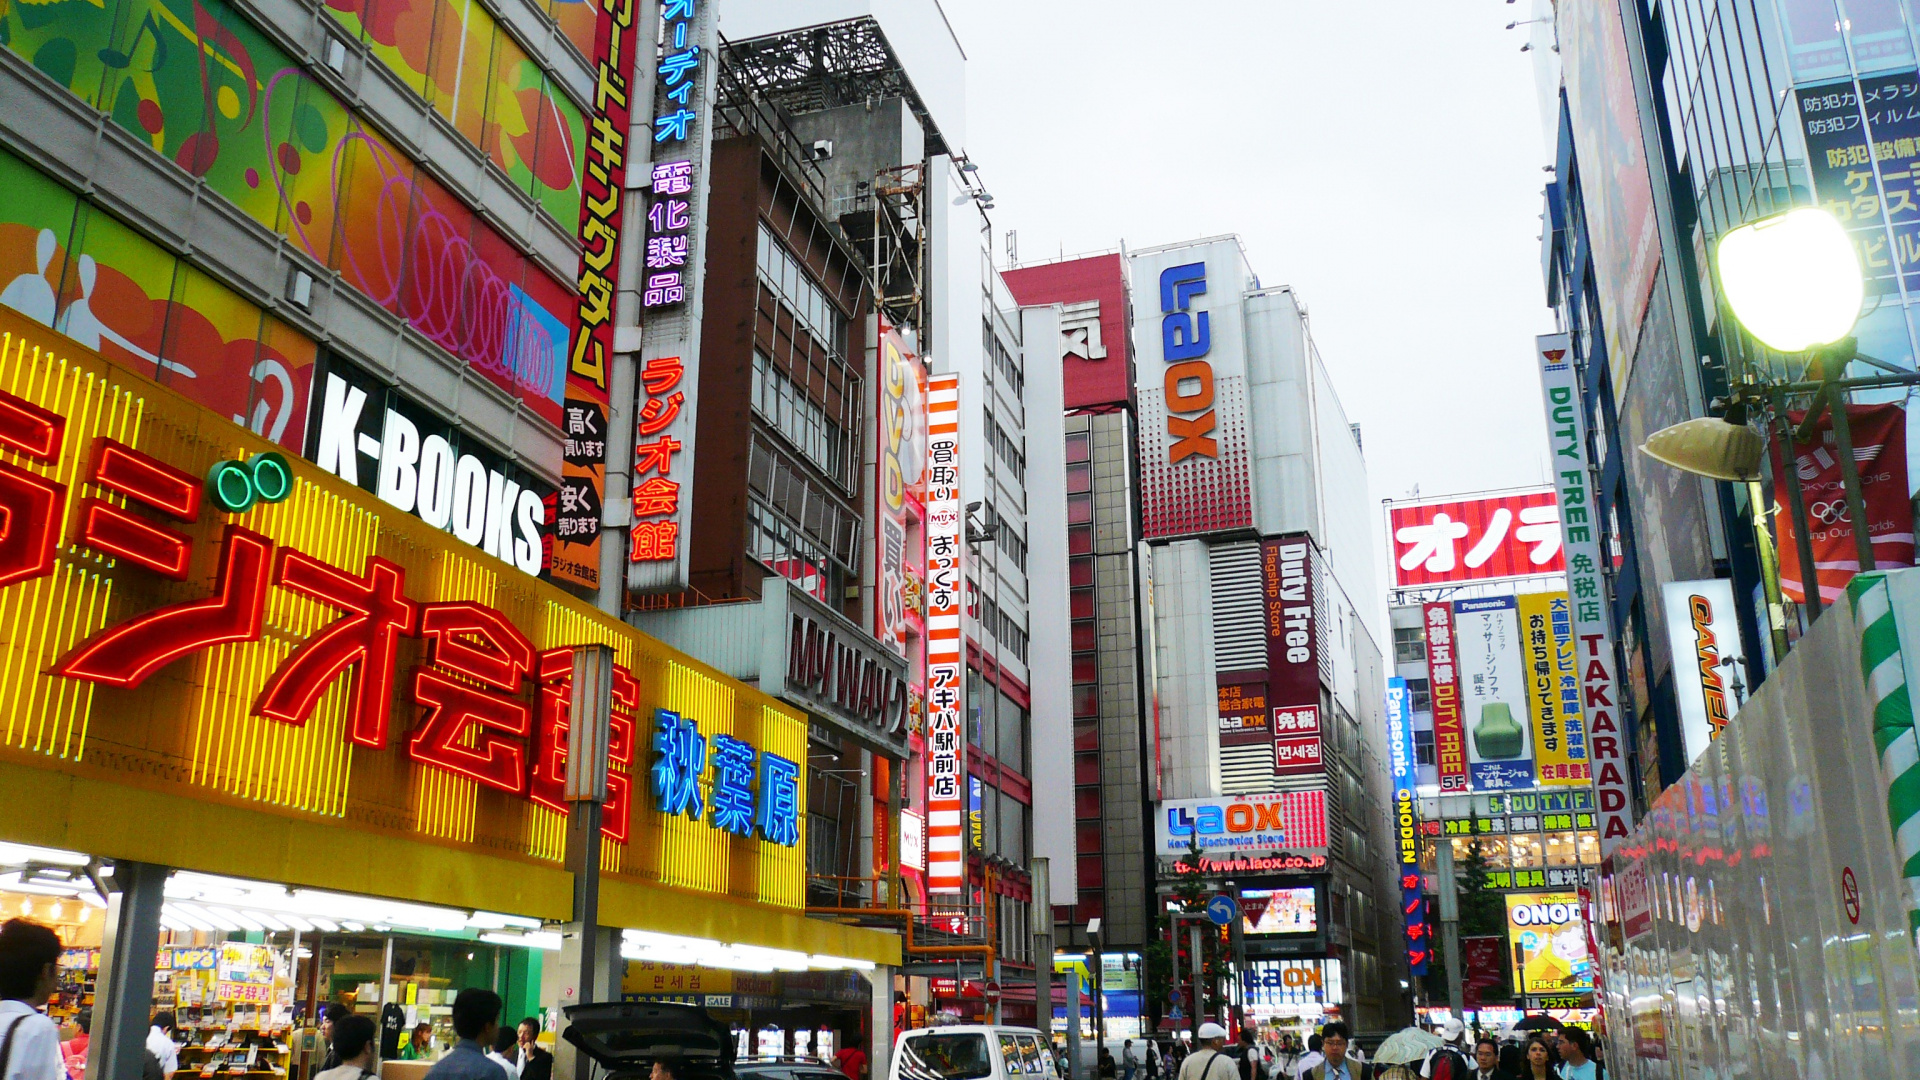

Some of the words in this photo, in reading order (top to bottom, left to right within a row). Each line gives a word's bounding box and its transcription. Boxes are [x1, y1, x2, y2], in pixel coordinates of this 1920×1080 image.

[643, 160, 694, 307] 電化製品
[566, 407, 598, 435] 高く
[884, 340, 904, 512] DVD
[1549, 386, 1579, 460] DUTY
[564, 440, 605, 459] 買います
[631, 356, 685, 563] ラジオ会館
[317, 371, 545, 577] K-BOOKS
[931, 441, 954, 501] 買取り
[560, 485, 592, 513] 安く
[930, 513, 958, 523] MUX
[1560, 469, 1591, 544] FREE
[558, 516, 599, 536] 売ります
[1829, 527, 1852, 538] Our
[1867, 520, 1895, 533] orlds
[552, 556, 598, 583] ラジオ会館店
[932, 535, 954, 609] まっくす
[1266, 546, 1280, 597] Flagship
[1280, 543, 1307, 601] Duty
[1570, 552, 1600, 623] 免税店
[1270, 601, 1281, 637] Store
[1462, 600, 1506, 611] Panasonic
[1284, 606, 1311, 663] Free
[1218, 686, 1241, 699] 本店
[1218, 697, 1265, 712] 総合家電
[1435, 686, 1457, 730] DUTY
[933, 667, 955, 796] アキバ駅前店
[1277, 710, 1316, 731] 免税
[1387, 687, 1410, 778] Panasonic
[1580, 633, 1628, 839] TAKARADA
[1278, 743, 1319, 760] 면세점
[1439, 733, 1462, 773] FREE
[652, 708, 801, 848] 秋葉原
[1442, 776, 1465, 789] 5F
[1199, 836, 1254, 847] Electronics
[1257, 834, 1285, 843] Store
[1397, 788, 1417, 864] ONODEN
[1403, 875, 1424, 965] オノデン
[219, 983, 269, 1001] 電子辞書
[654, 975, 700, 989] 면세점
[707, 996, 730, 1006] SALE
[736, 977, 772, 992] DISCOUNT
